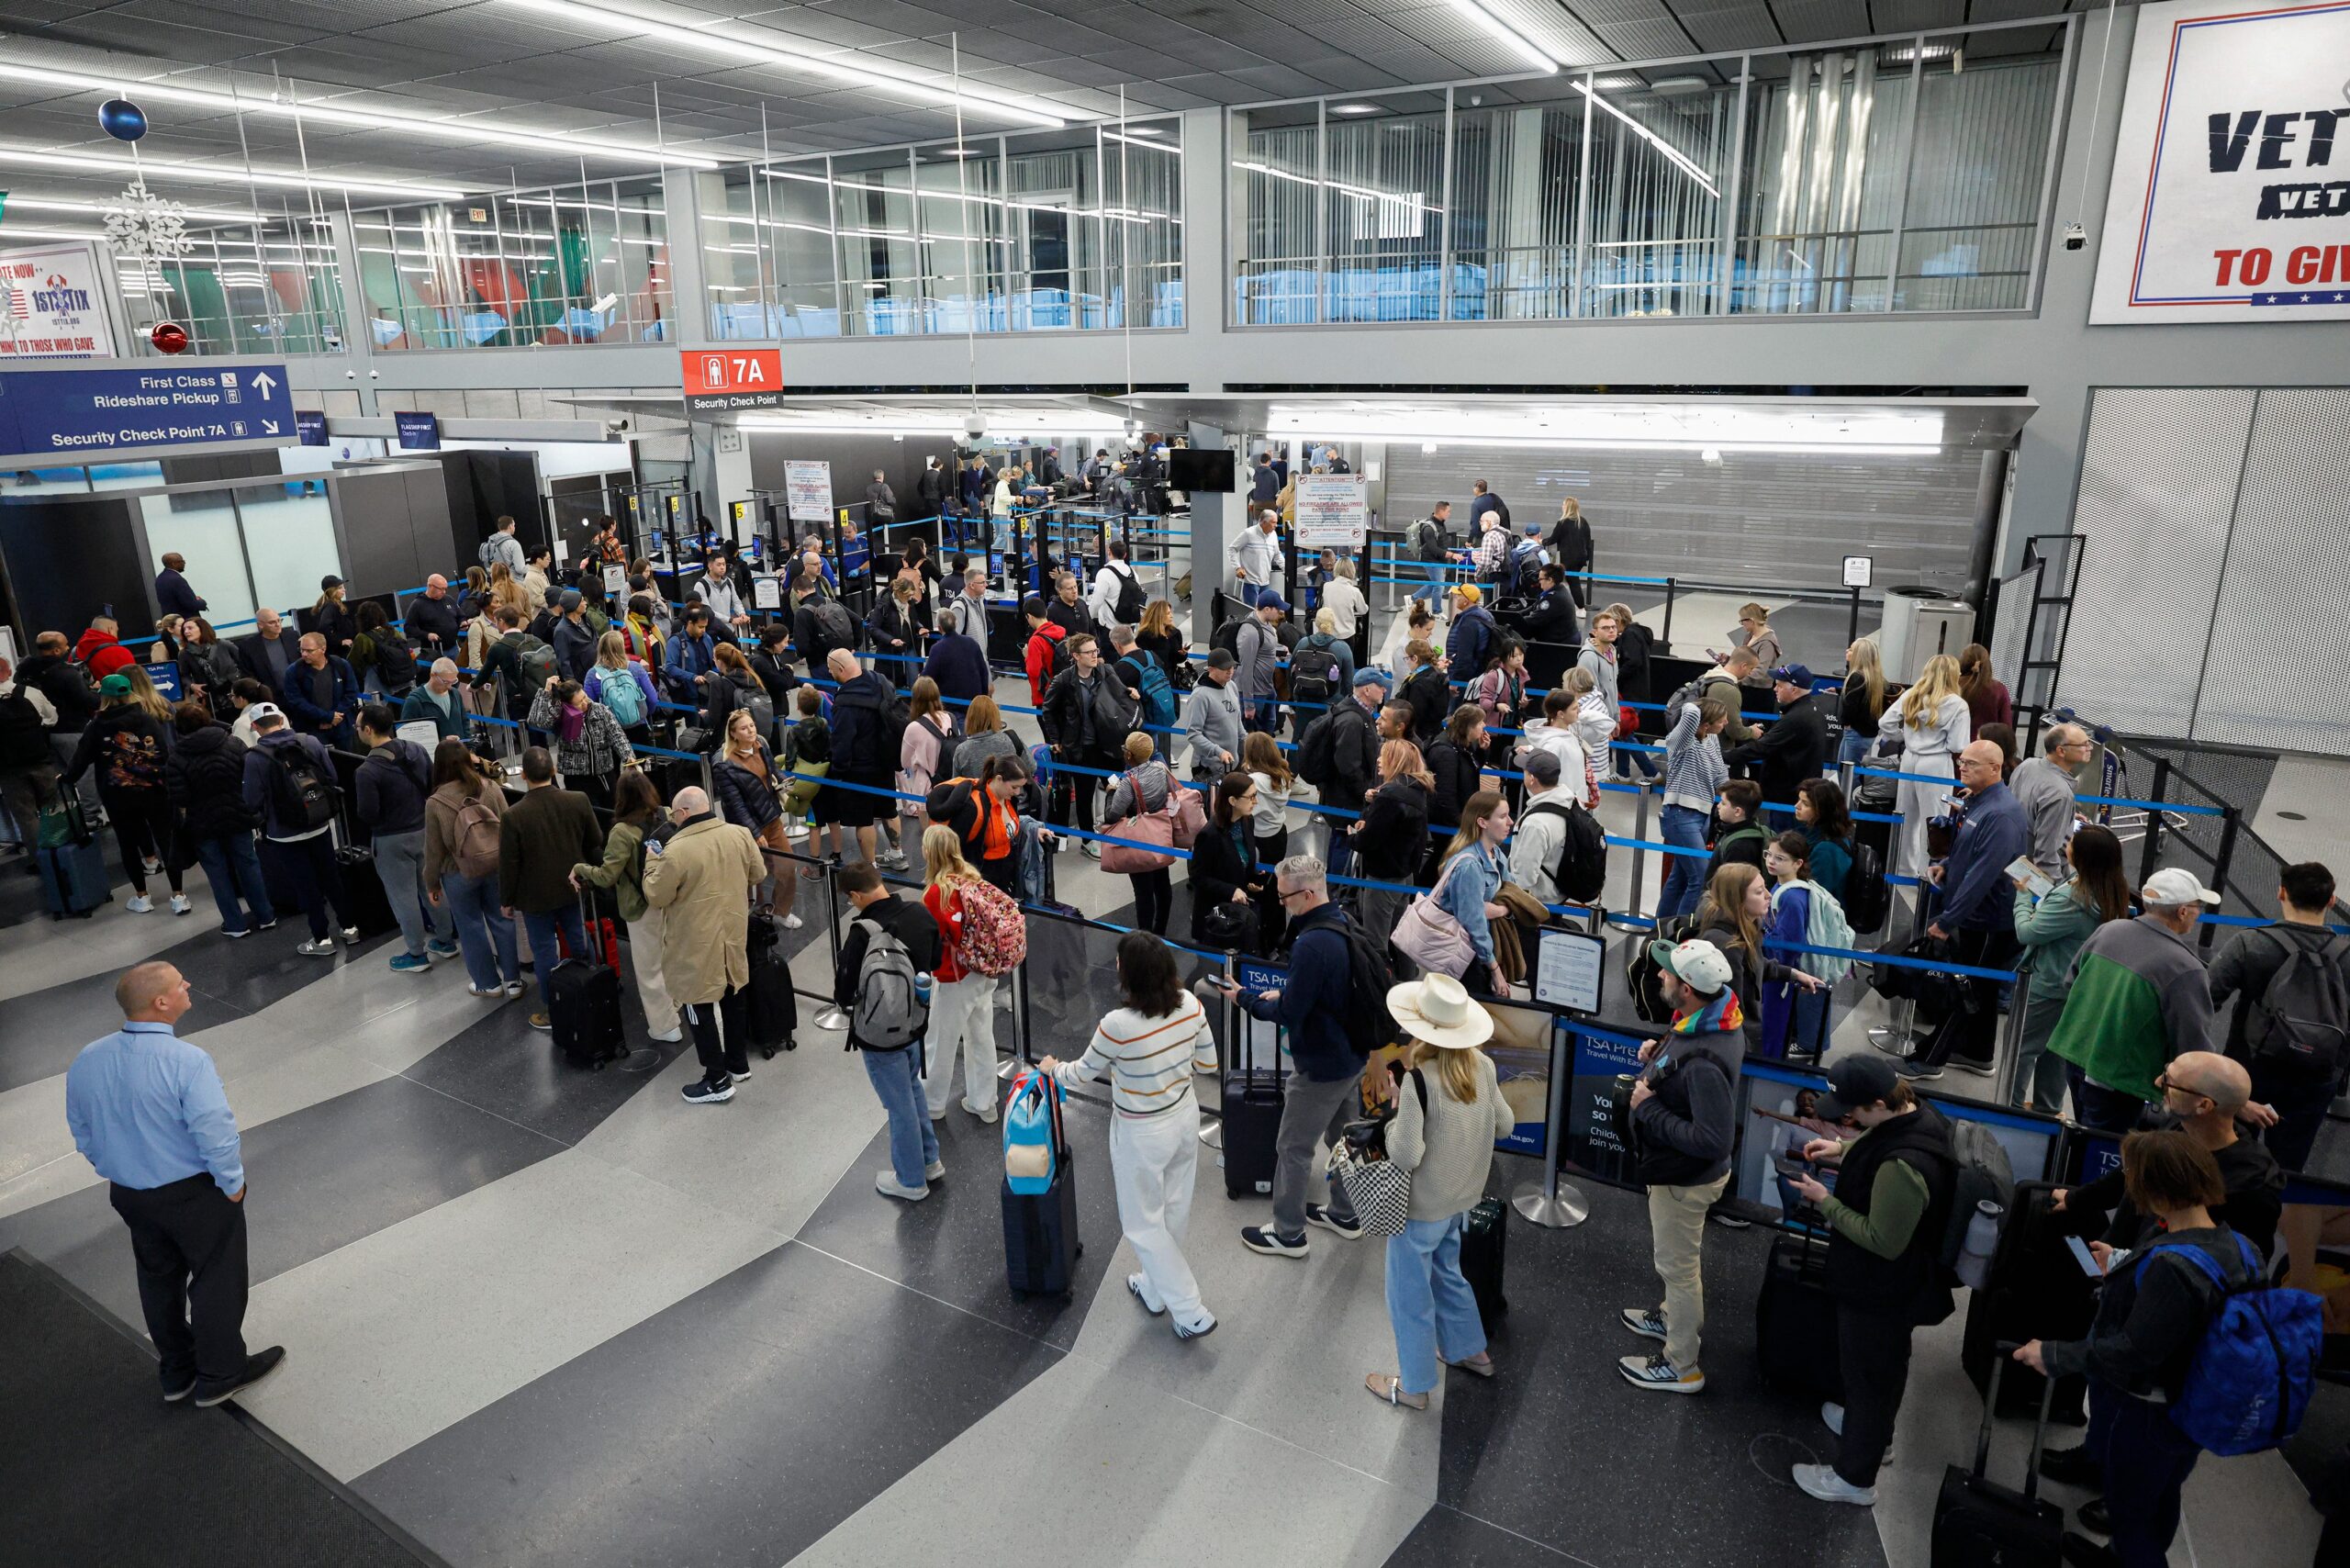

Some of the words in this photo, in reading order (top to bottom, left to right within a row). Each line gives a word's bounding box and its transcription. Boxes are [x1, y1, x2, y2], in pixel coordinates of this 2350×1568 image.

[2279, 188, 2346, 210] VET
[13, 263, 35, 279] NOW
[2213, 247, 2272, 286] TO
[0, 340, 17, 353] HING
[18, 339, 28, 353] TO
[29, 338, 53, 352] THOSE
[54, 337, 73, 352] WHO
[73, 337, 95, 351] GAVE
[733, 359, 765, 383] 7A
[140, 376, 173, 389] First
[176, 375, 217, 387] Class
[94, 394, 169, 408] Rideshare
[173, 392, 219, 406] Pickup
[694, 398, 728, 409] Security
[730, 396, 755, 407] Check
[757, 395, 778, 405] Point
[51, 431, 116, 447] Security
[120, 428, 166, 442] Check
[169, 425, 205, 439] Point
[207, 424, 227, 436] 7A
[1248, 970, 1270, 984] TSA
[1585, 1035, 1610, 1051] TSA
[1614, 1043, 1636, 1057] Pre
[1586, 1048, 1607, 1059] Travel
[1609, 1053, 1626, 1064] With
[1627, 1058, 1644, 1068] Ease
[1592, 1110, 1606, 1121] so
[1510, 1135, 1535, 1144] tsa.gov
[1589, 1137, 1606, 1148] join
[2099, 1150, 2121, 1168] TS
